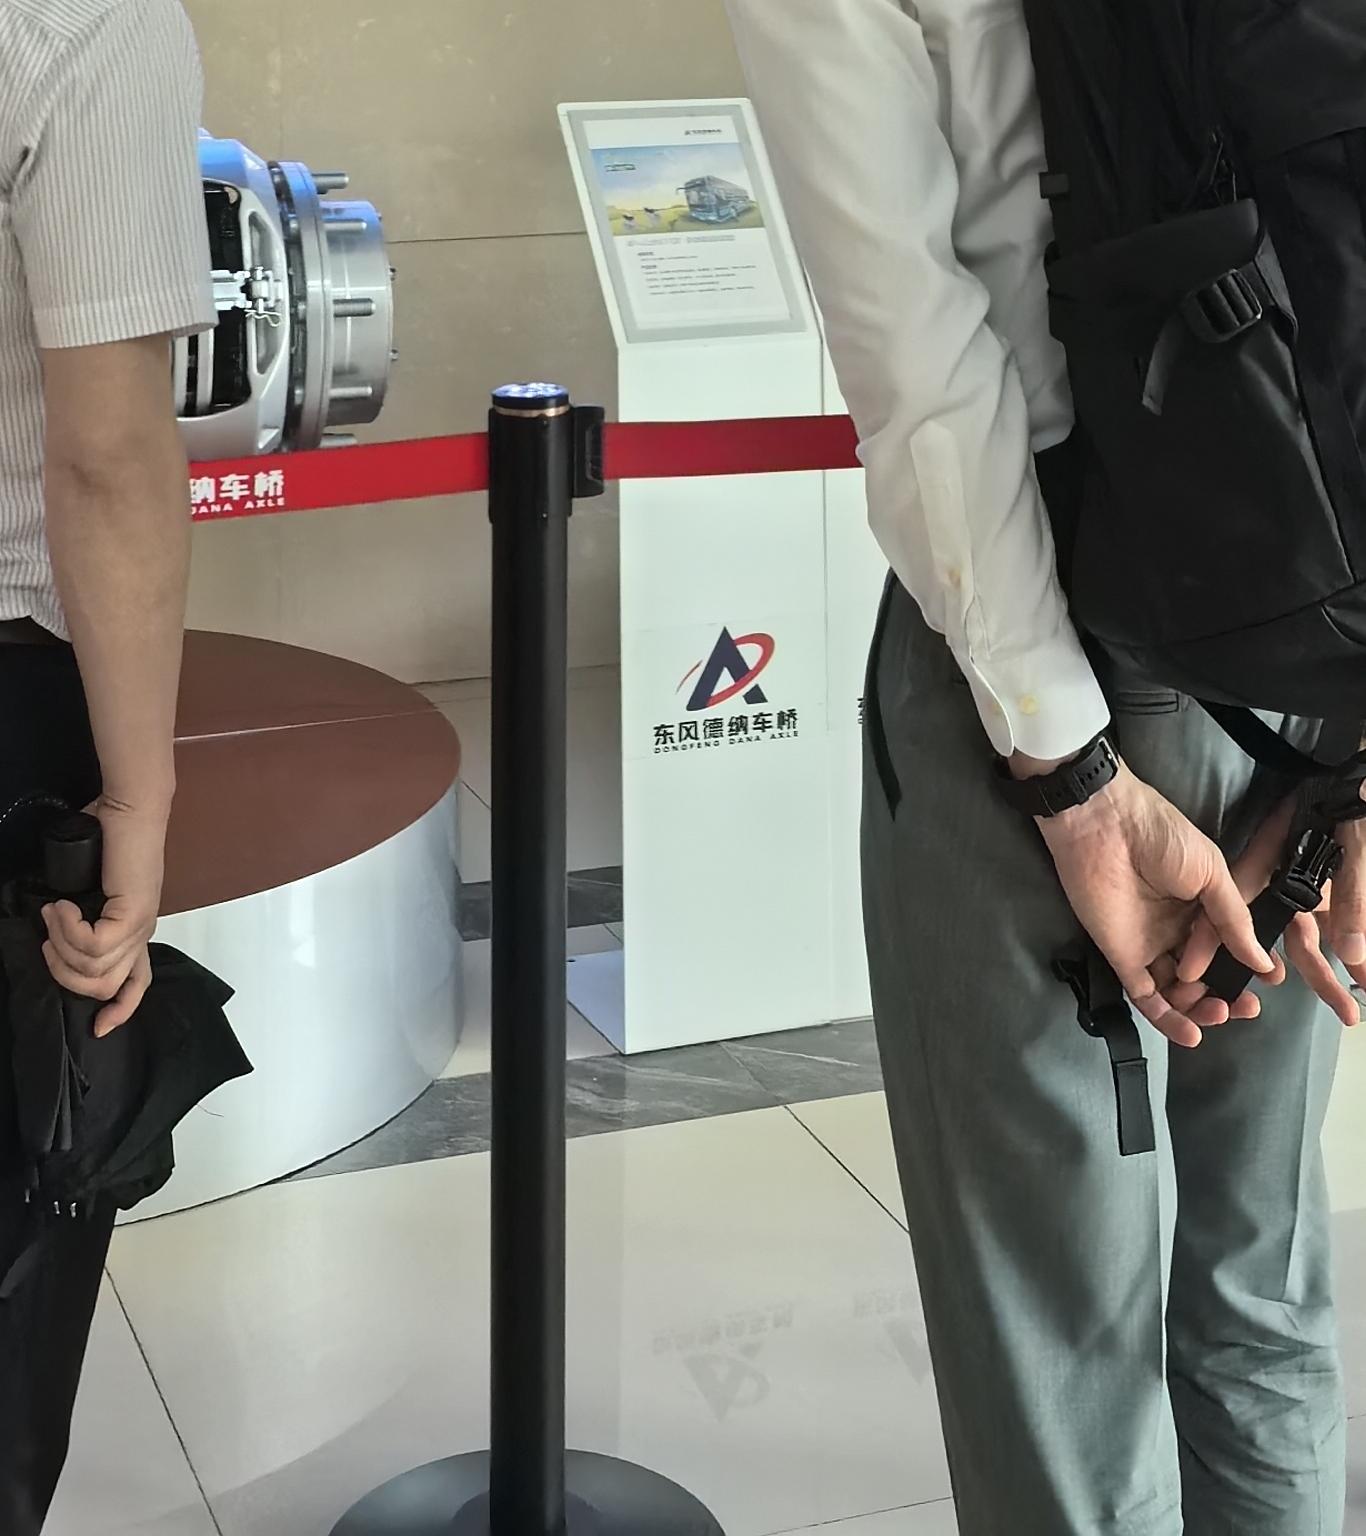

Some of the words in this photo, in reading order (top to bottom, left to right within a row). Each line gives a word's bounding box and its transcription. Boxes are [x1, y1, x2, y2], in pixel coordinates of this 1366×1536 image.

[244, 498, 285, 509] AXLE
[653, 709, 799, 746] 东风德纳车桥
[654, 740, 720, 754] DONGFENG
[729, 735, 761, 745] DANA
[770, 730, 798, 740] AXLE
